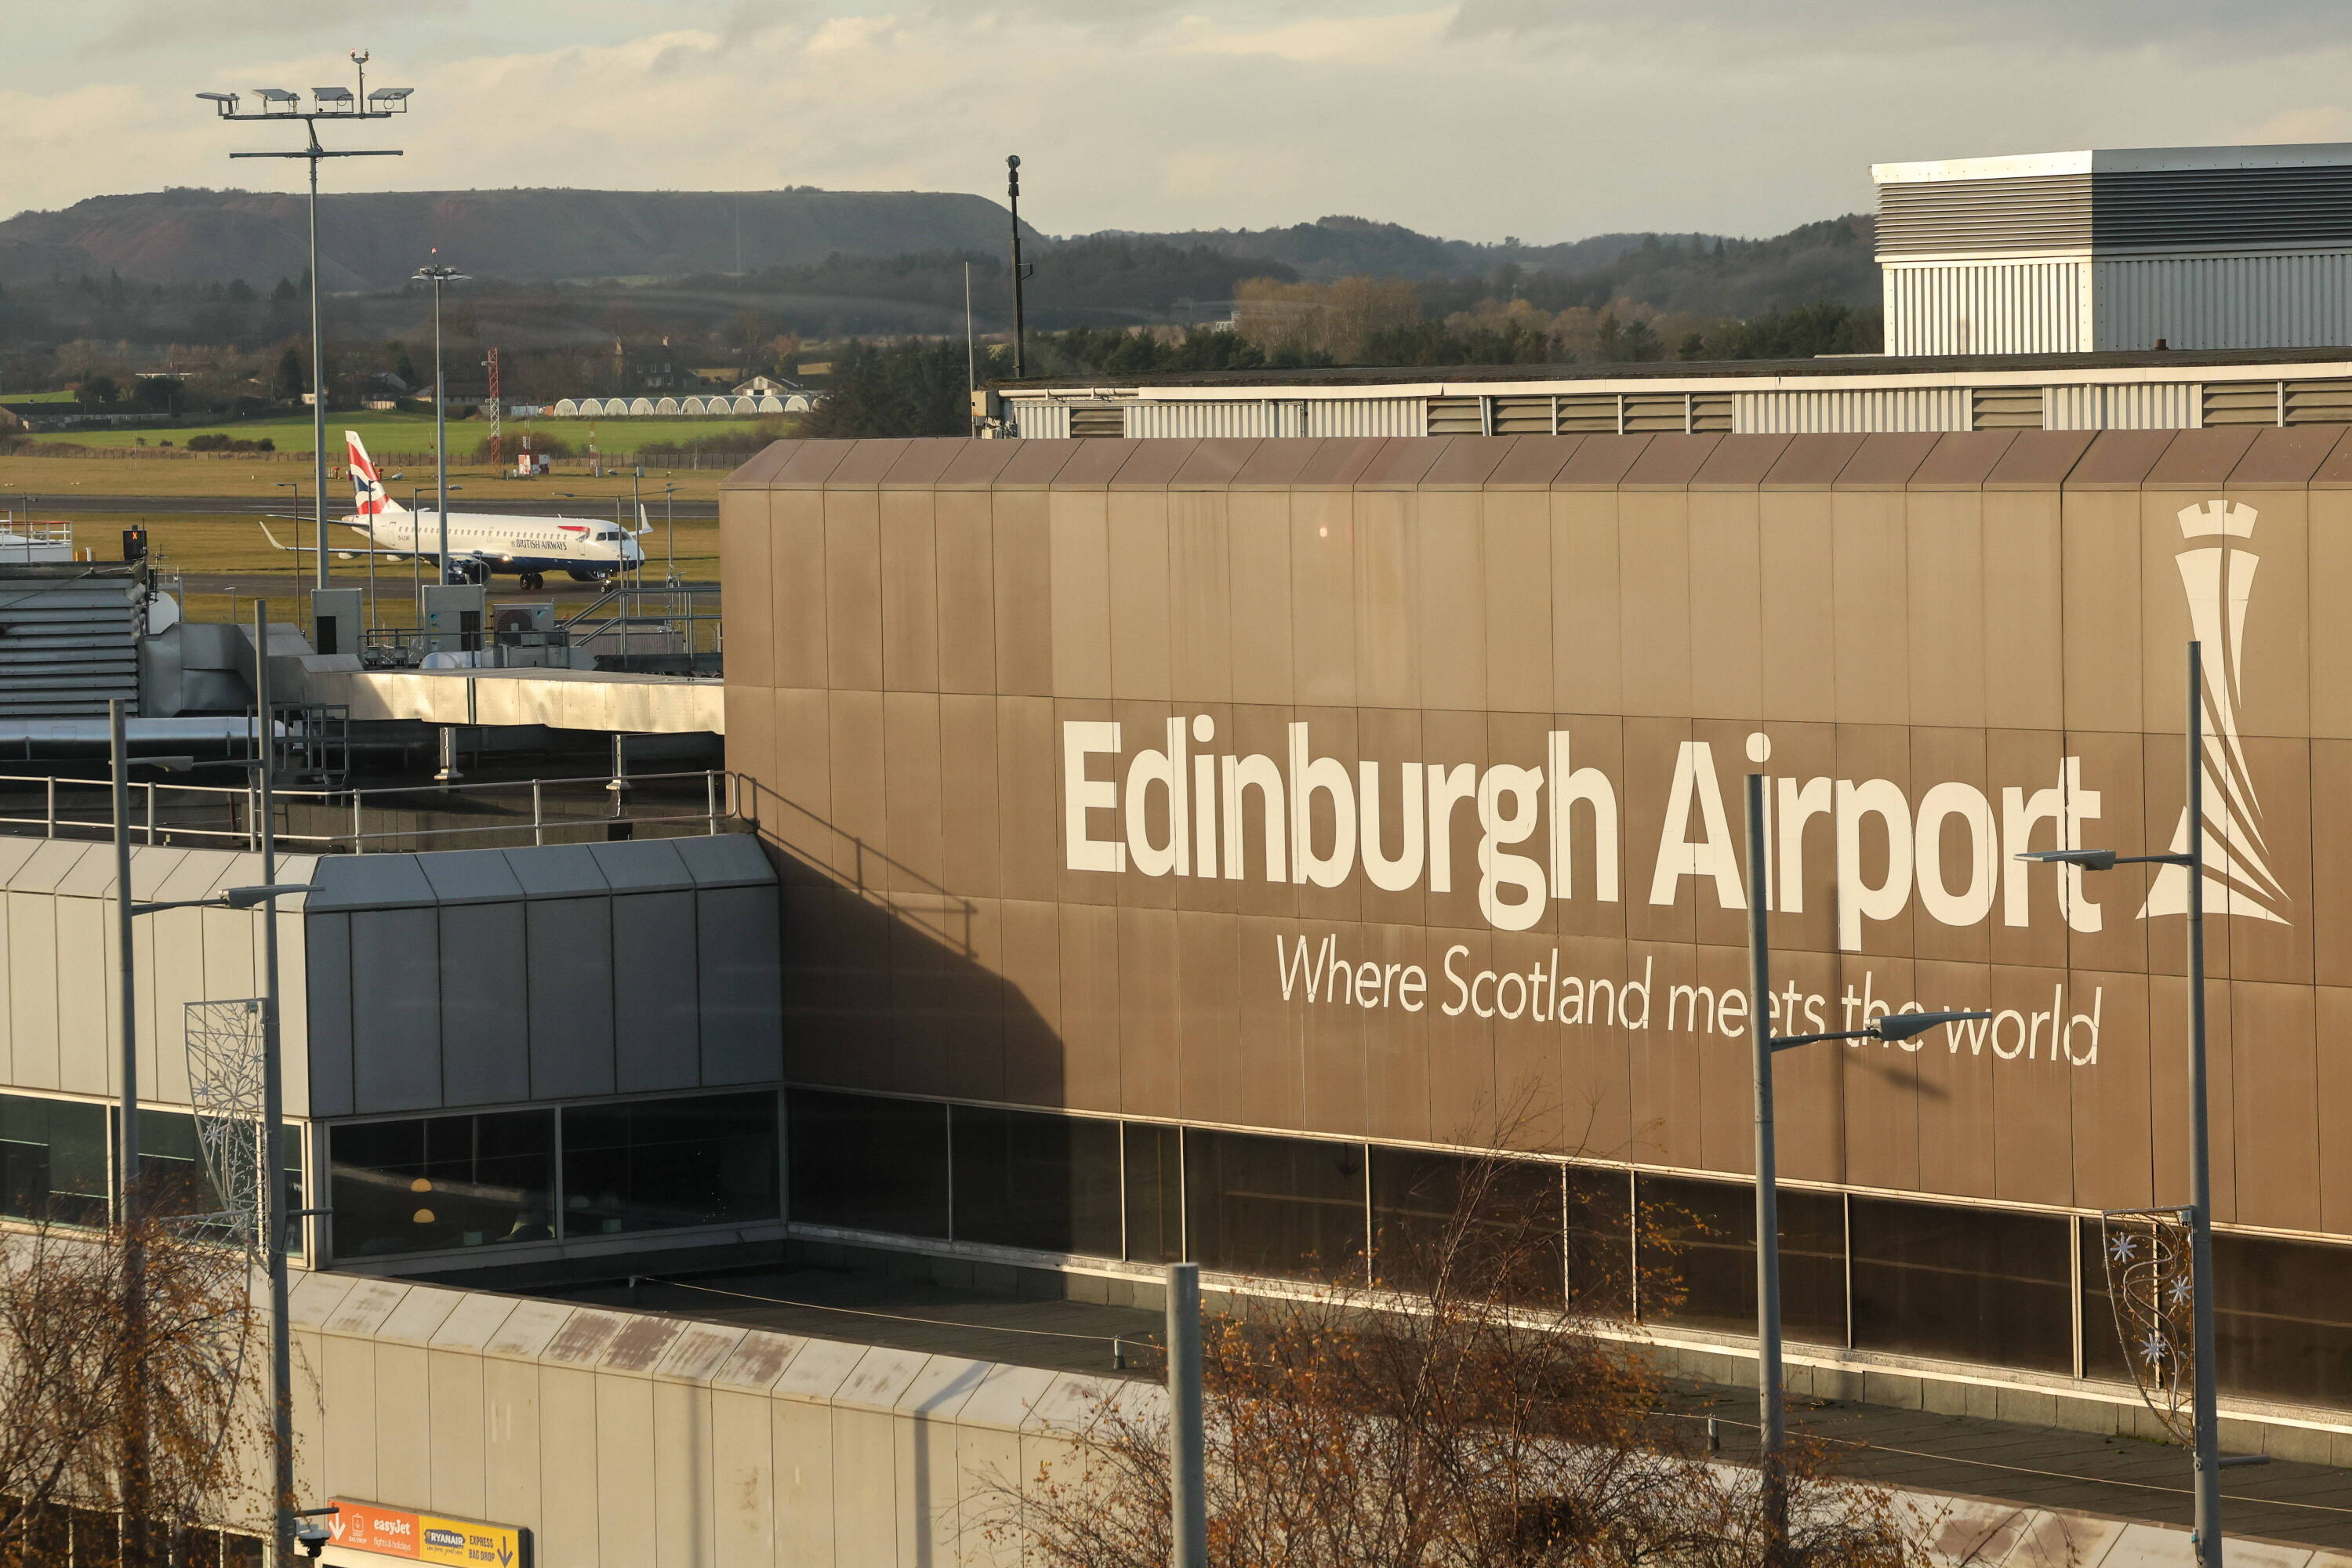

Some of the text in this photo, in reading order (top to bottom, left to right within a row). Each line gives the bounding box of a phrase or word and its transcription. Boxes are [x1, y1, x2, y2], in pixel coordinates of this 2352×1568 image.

[517, 539, 567, 550] BRITISH AIRWAYS
[1063, 713, 2103, 952] Edinburgh Airport
[1276, 933, 1427, 1011] Where
[1440, 945, 1653, 1031] Scotland
[1944, 983, 2102, 1066] world
[374, 1519, 411, 1535] easyJet
[430, 1532, 464, 1546] RYANAIR
[469, 1535, 494, 1548] EXPRESS
[468, 1548, 495, 1563] BAG DROP
